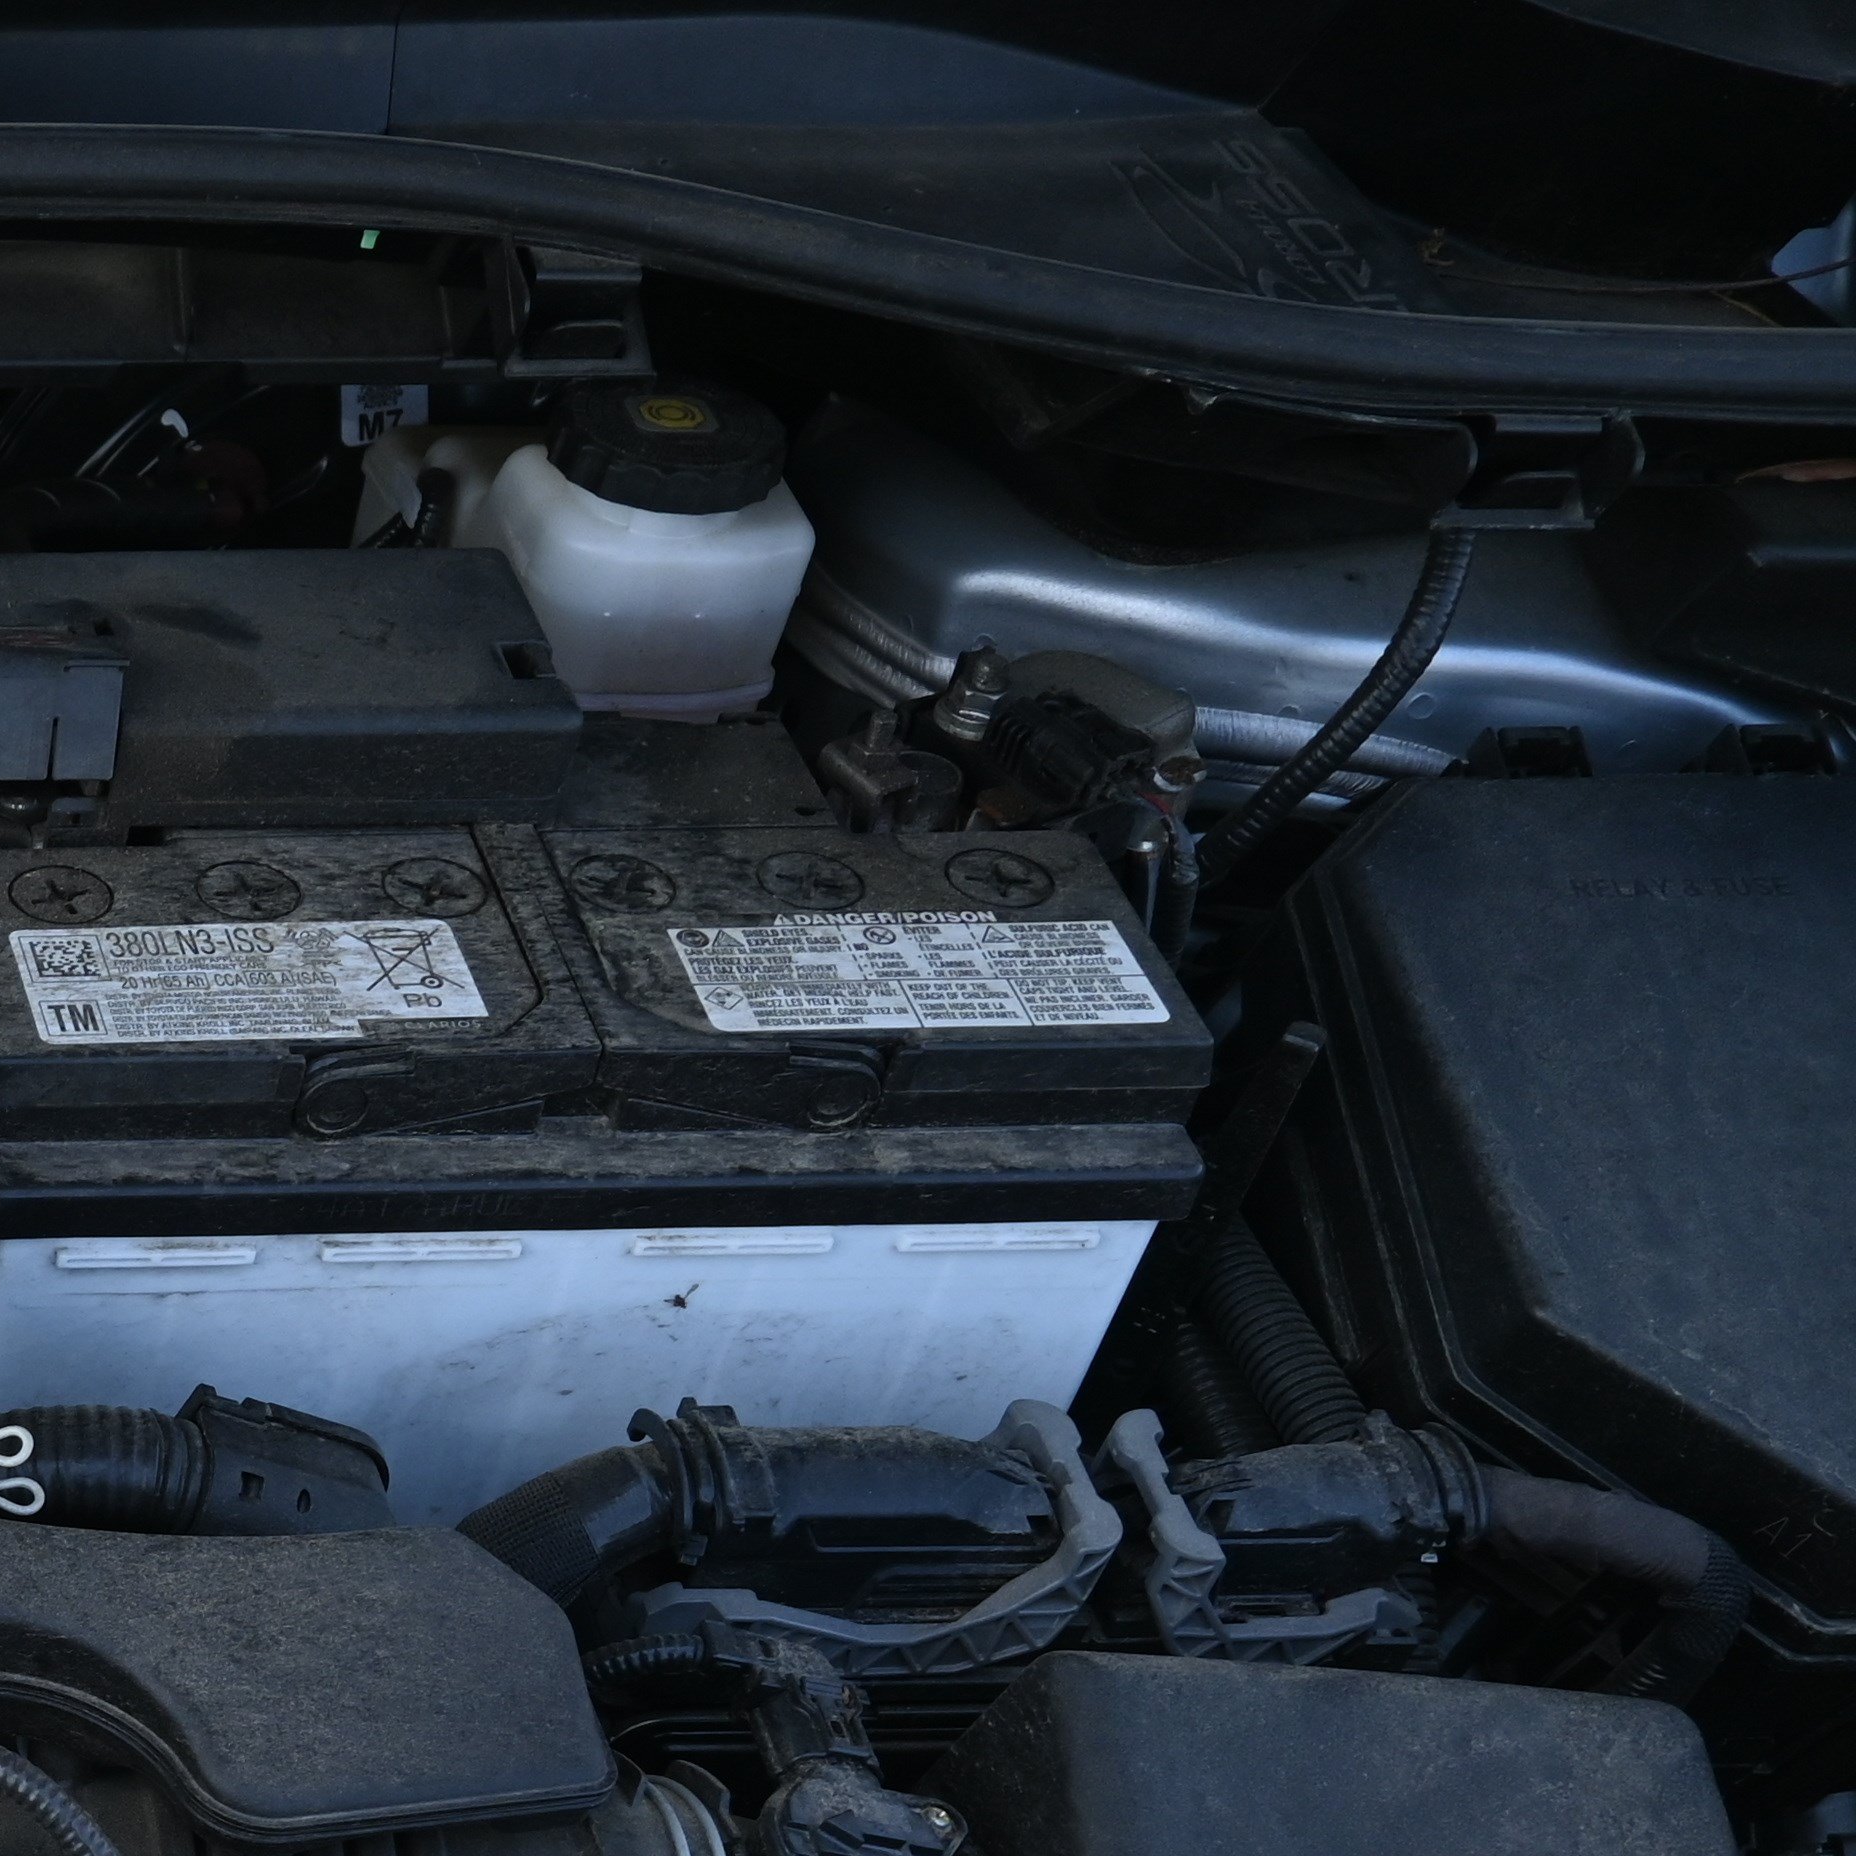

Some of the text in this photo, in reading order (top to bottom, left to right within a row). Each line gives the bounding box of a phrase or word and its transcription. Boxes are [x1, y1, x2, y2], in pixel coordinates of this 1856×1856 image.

[1212, 139, 1401, 305] ROSS
[792, 910, 997, 926] DANGER/POISON
[1062, 923, 1088, 931] ACID
[1090, 923, 1110, 931] CAN
[105, 927, 274, 957] 380LN3-ISS
[120, 976, 139, 990] 20
[213, 972, 245, 987] CCA
[403, 992, 443, 1009] Pb
[47, 1003, 101, 1032] TM
